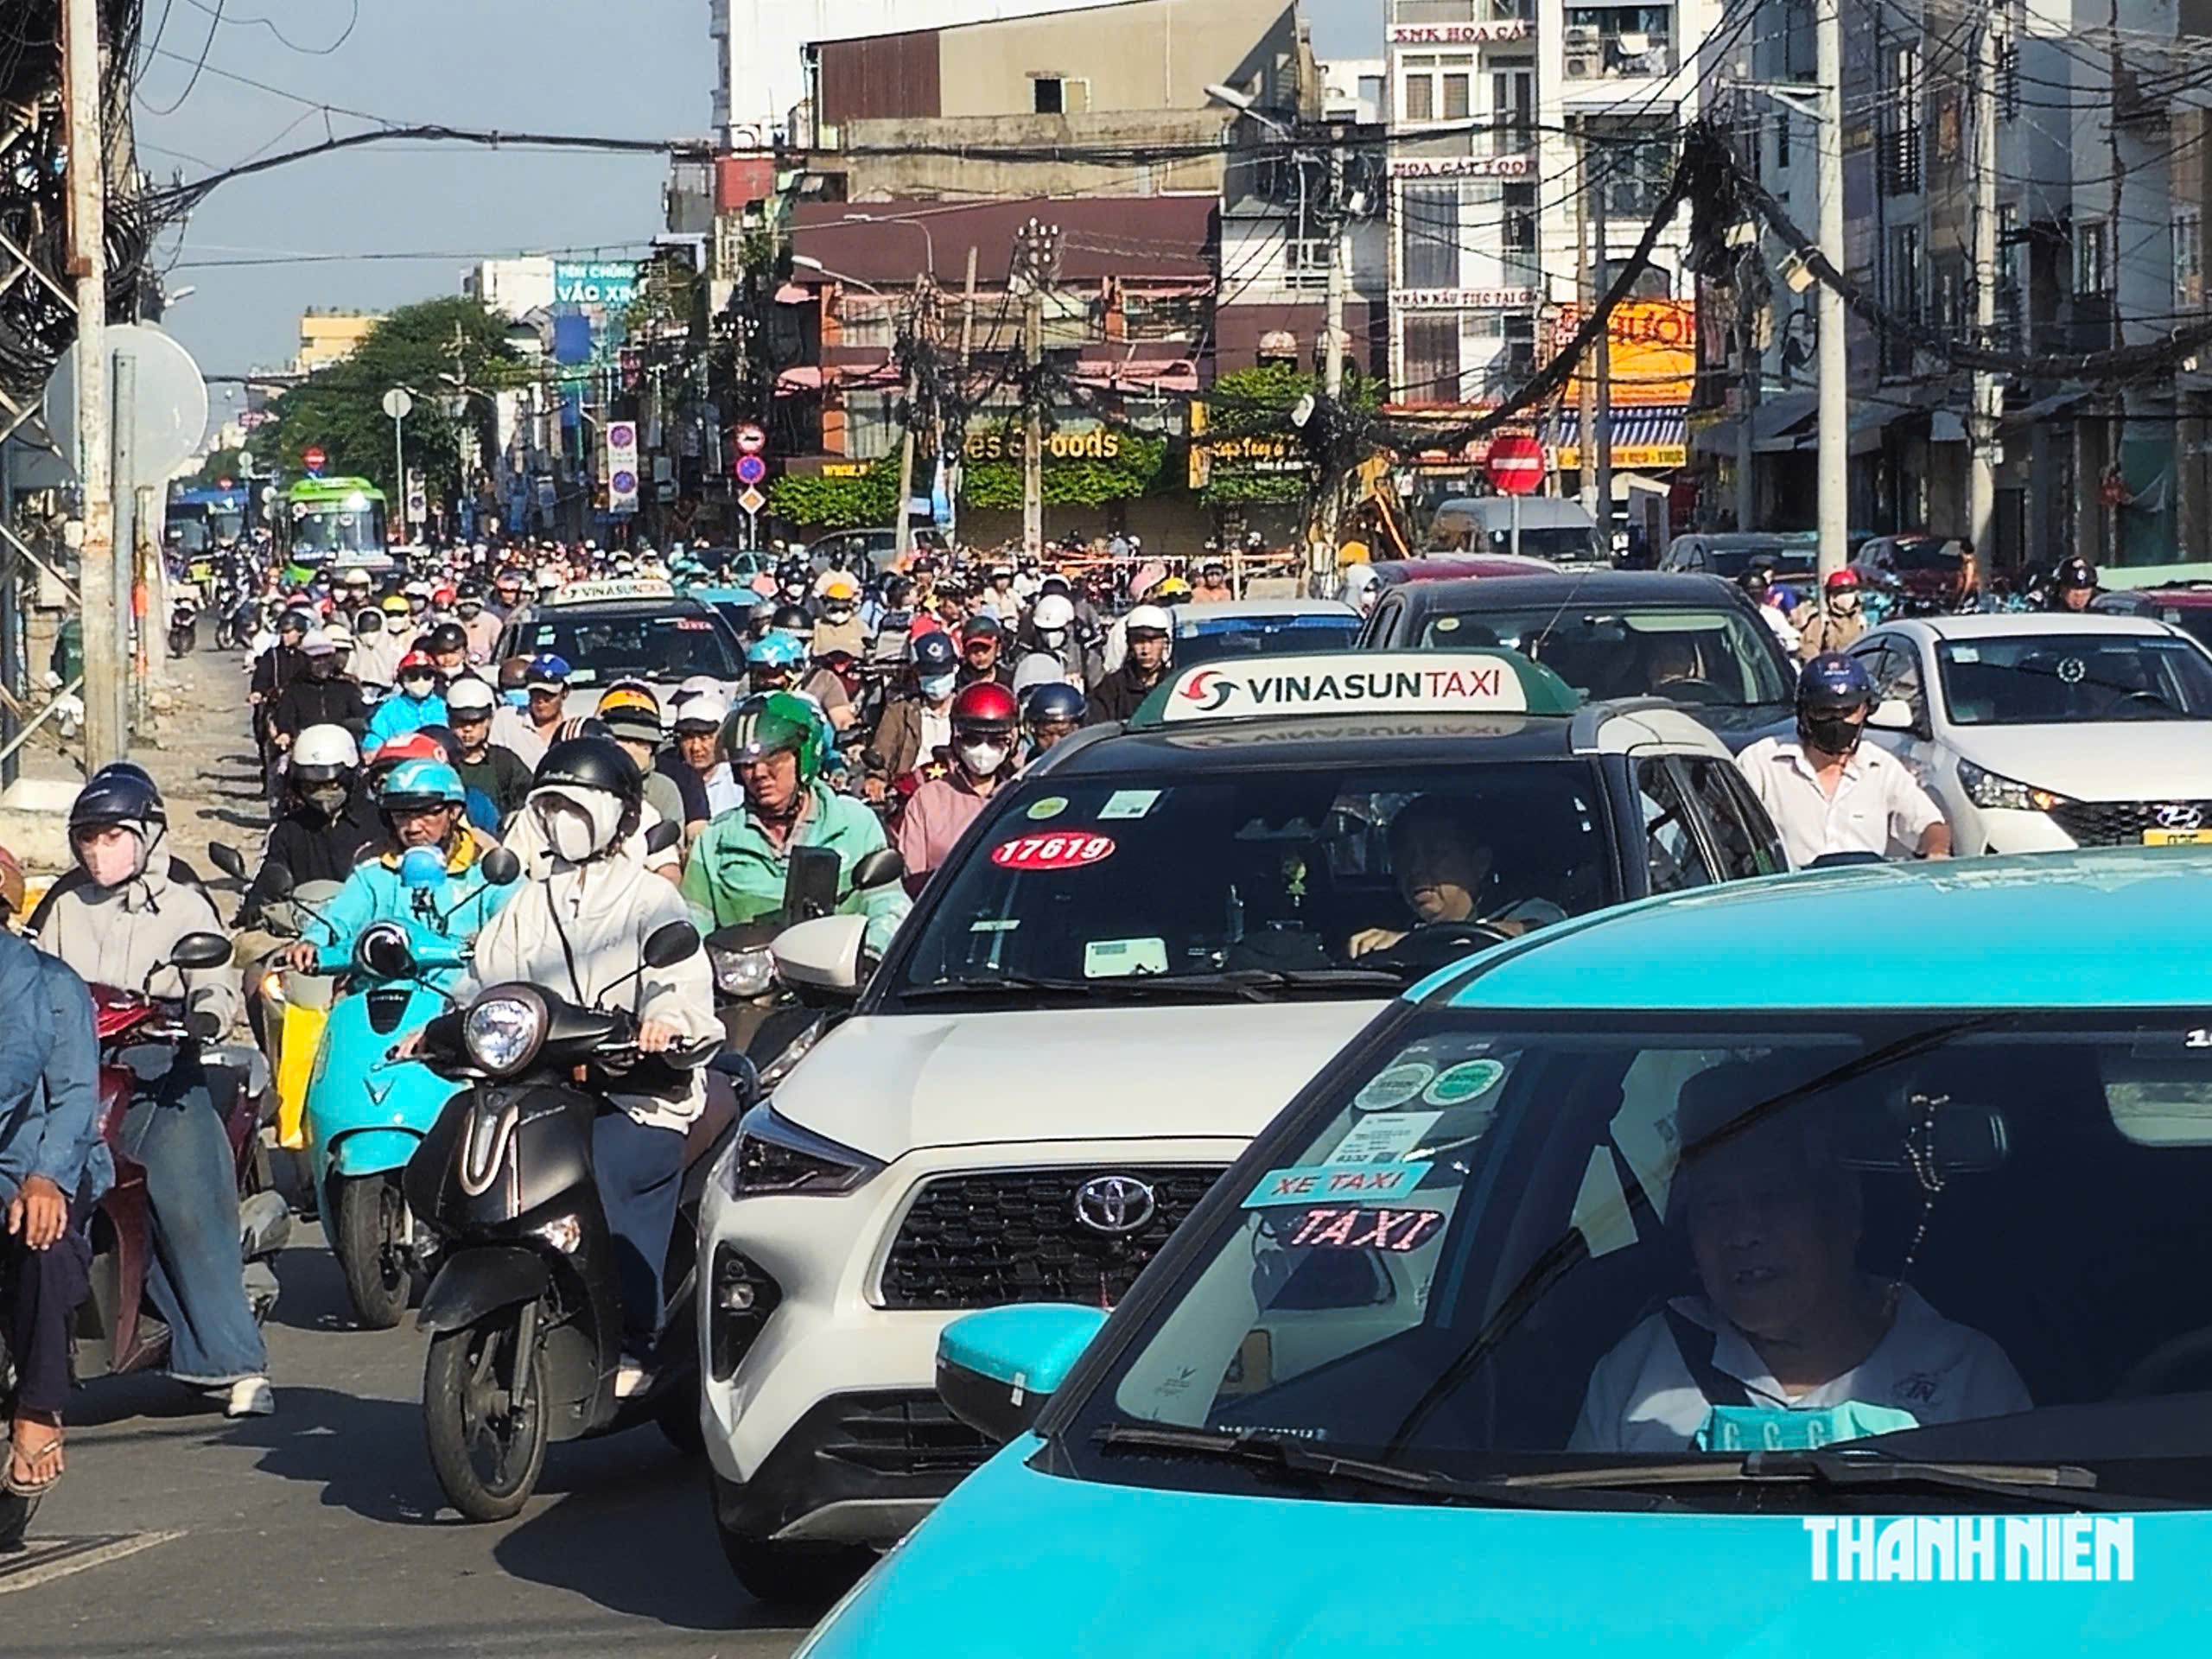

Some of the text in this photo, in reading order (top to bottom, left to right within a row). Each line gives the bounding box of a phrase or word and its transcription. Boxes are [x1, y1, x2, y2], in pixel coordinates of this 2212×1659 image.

[1446, 27, 1489, 41] HOA
[1393, 162, 1433, 175] HOA
[1000, 838, 1109, 861] 17619
[1271, 1171, 1405, 1195] XE TAXI
[1292, 1210, 1439, 1249] TAXI
